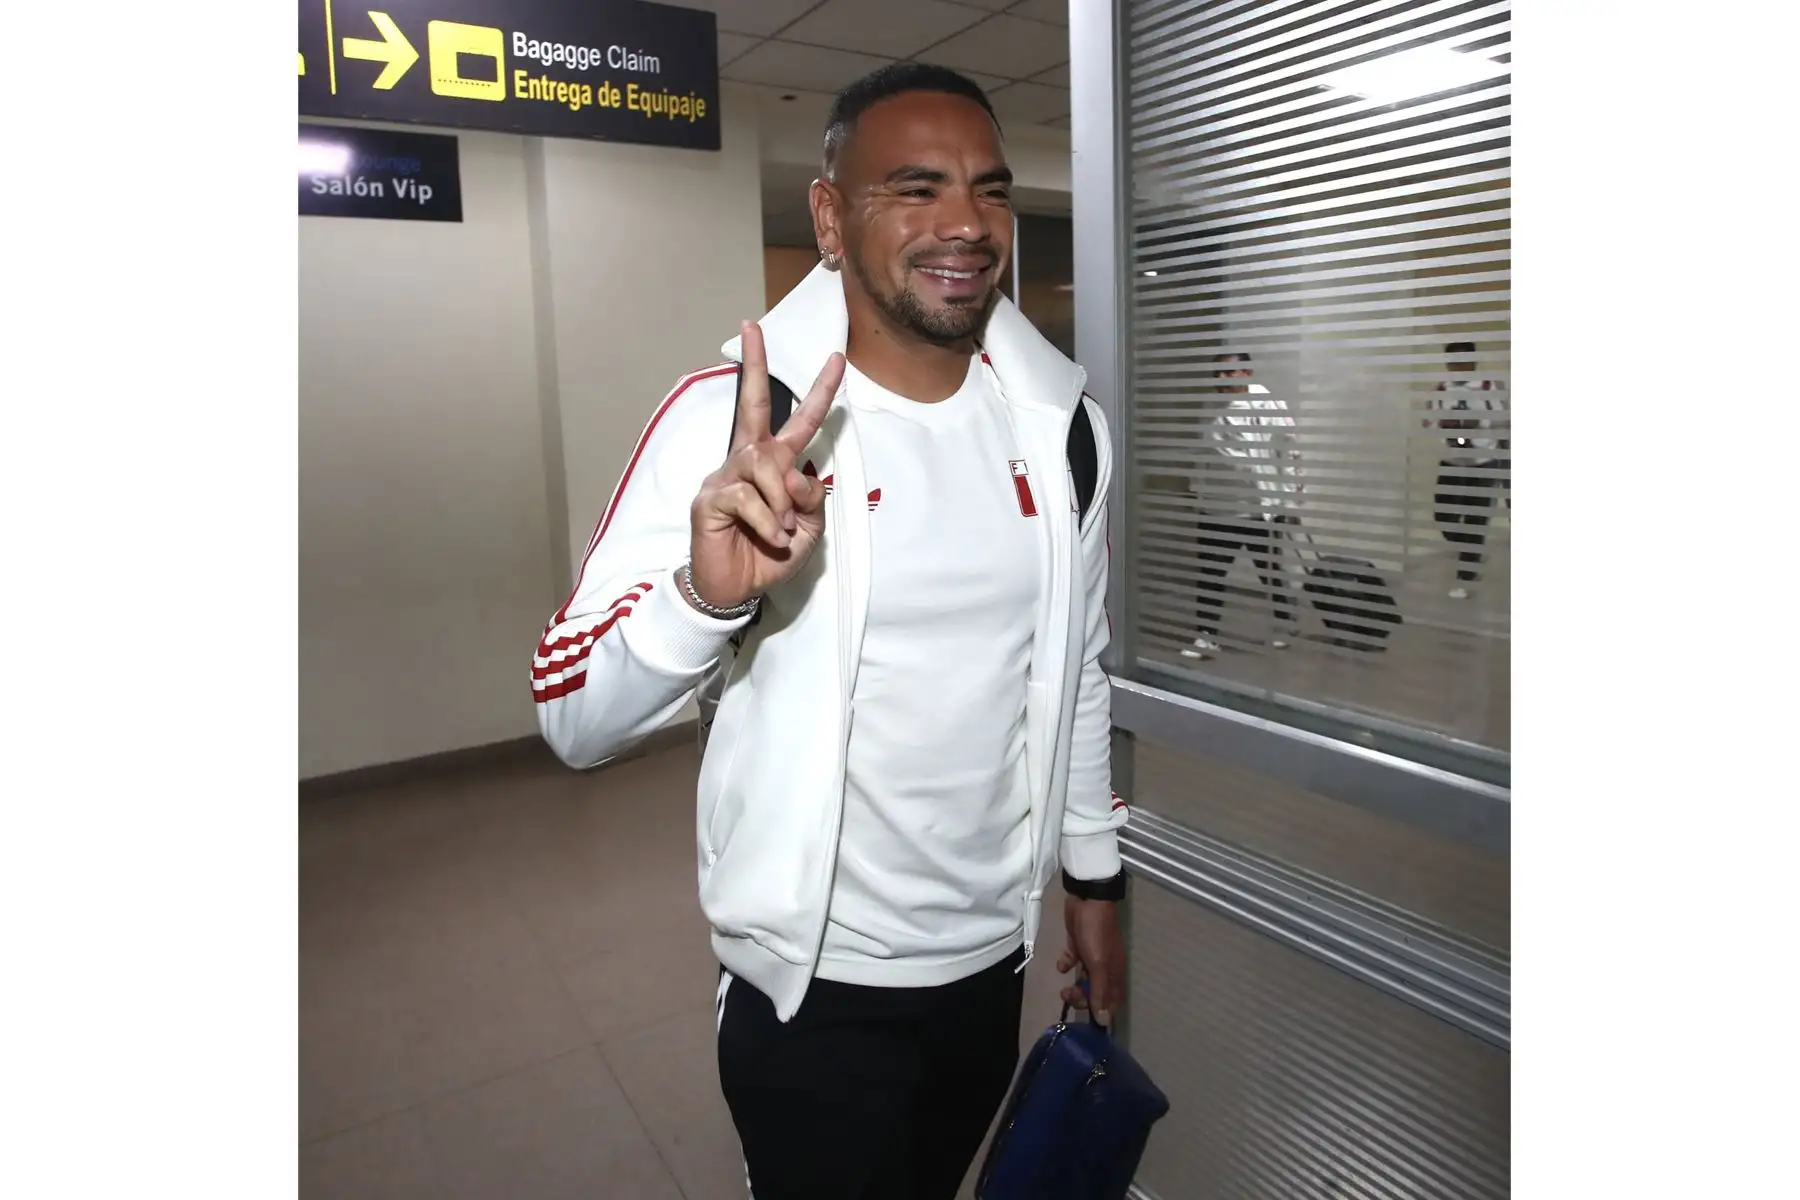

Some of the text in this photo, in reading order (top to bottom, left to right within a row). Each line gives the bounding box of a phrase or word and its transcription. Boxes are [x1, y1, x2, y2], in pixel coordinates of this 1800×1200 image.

[512, 31, 660, 74] Bagagge Claim
[514, 69, 706, 123] Entrega de Equipaje
[311, 174, 433, 205] Salón Vip
